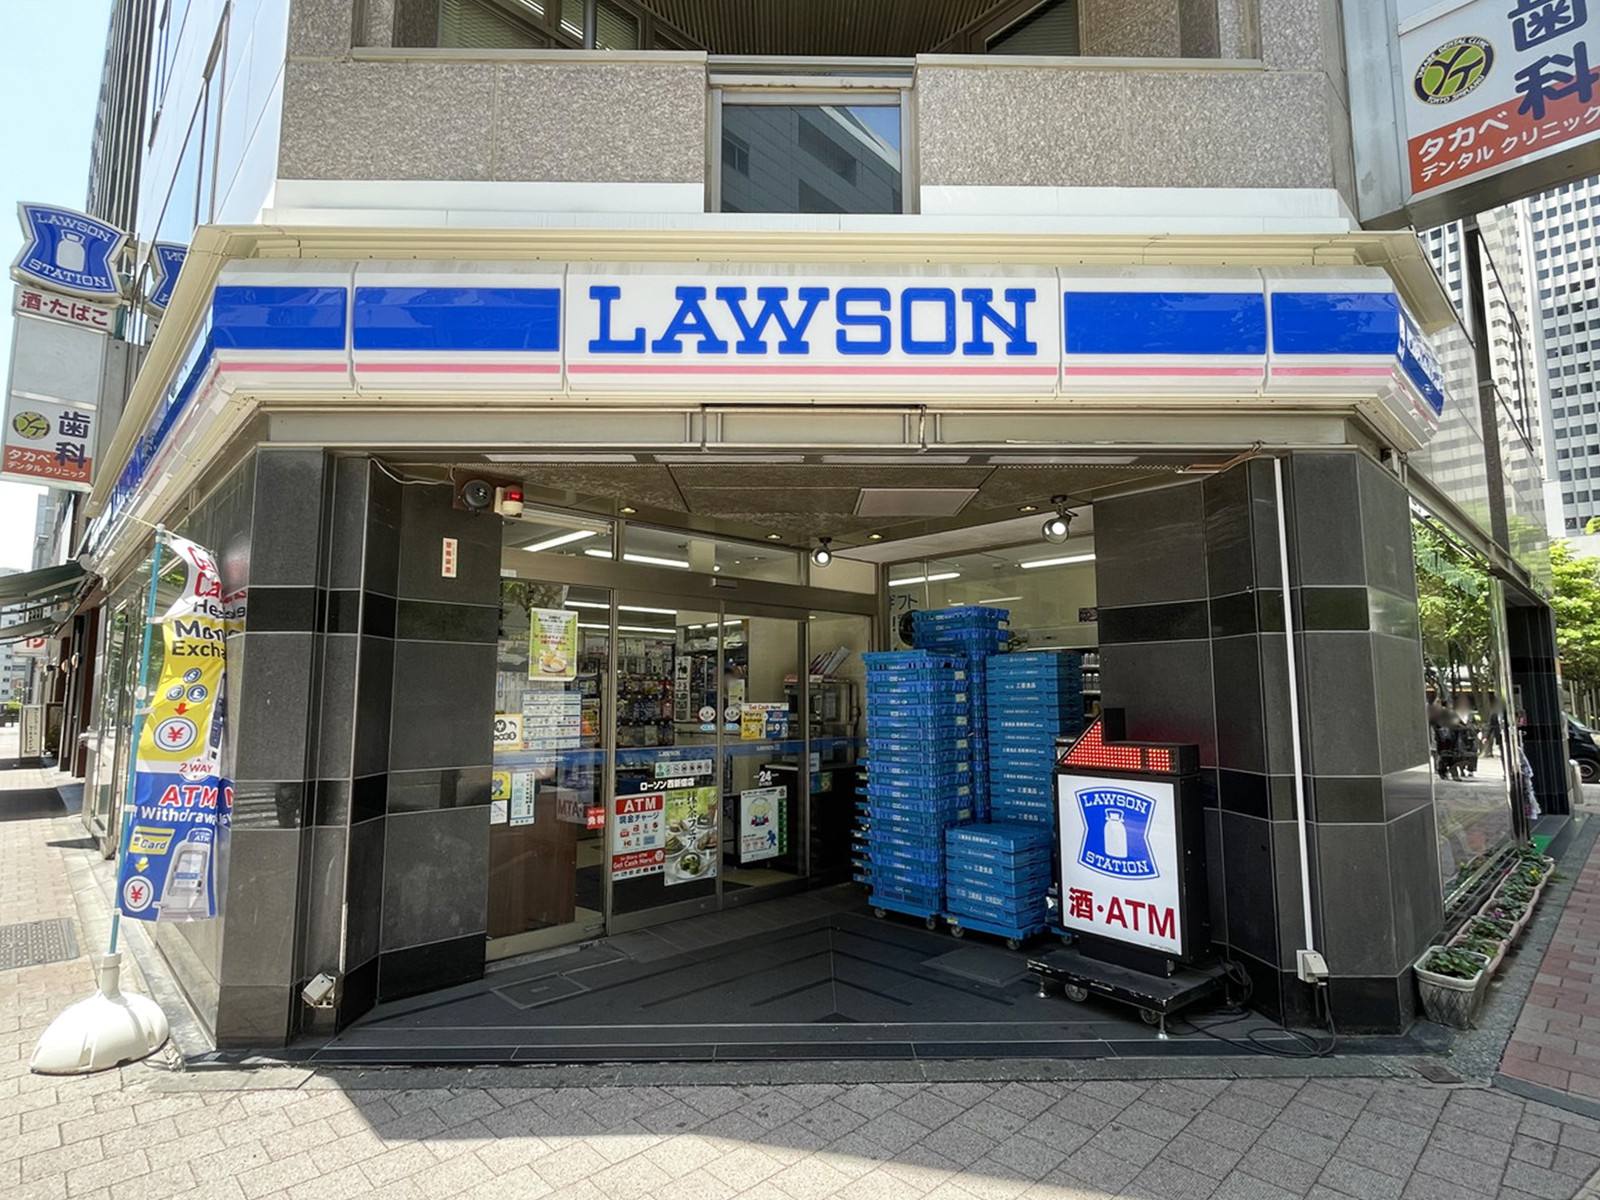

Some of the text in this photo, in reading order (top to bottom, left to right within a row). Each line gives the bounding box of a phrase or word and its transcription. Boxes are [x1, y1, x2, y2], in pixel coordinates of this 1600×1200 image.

[1420, 105, 1600, 183] デンタル クリニック
[36, 212, 112, 243] LAWSON
[28, 258, 109, 288] STATION
[588, 286, 1037, 356] LAWSON
[54, 410, 92, 469] 歯科
[7, 460, 87, 479] デンタル クリニック
[179, 763, 213, 773] 2 WAY
[759, 770, 772, 782] 24
[159, 785, 218, 808] ATM
[623, 797, 657, 813] ATM
[1082, 793, 1148, 814] LAWSON
[140, 839, 168, 850] Card
[624, 859, 639, 868] Cash
[1085, 851, 1150, 873] STATION
